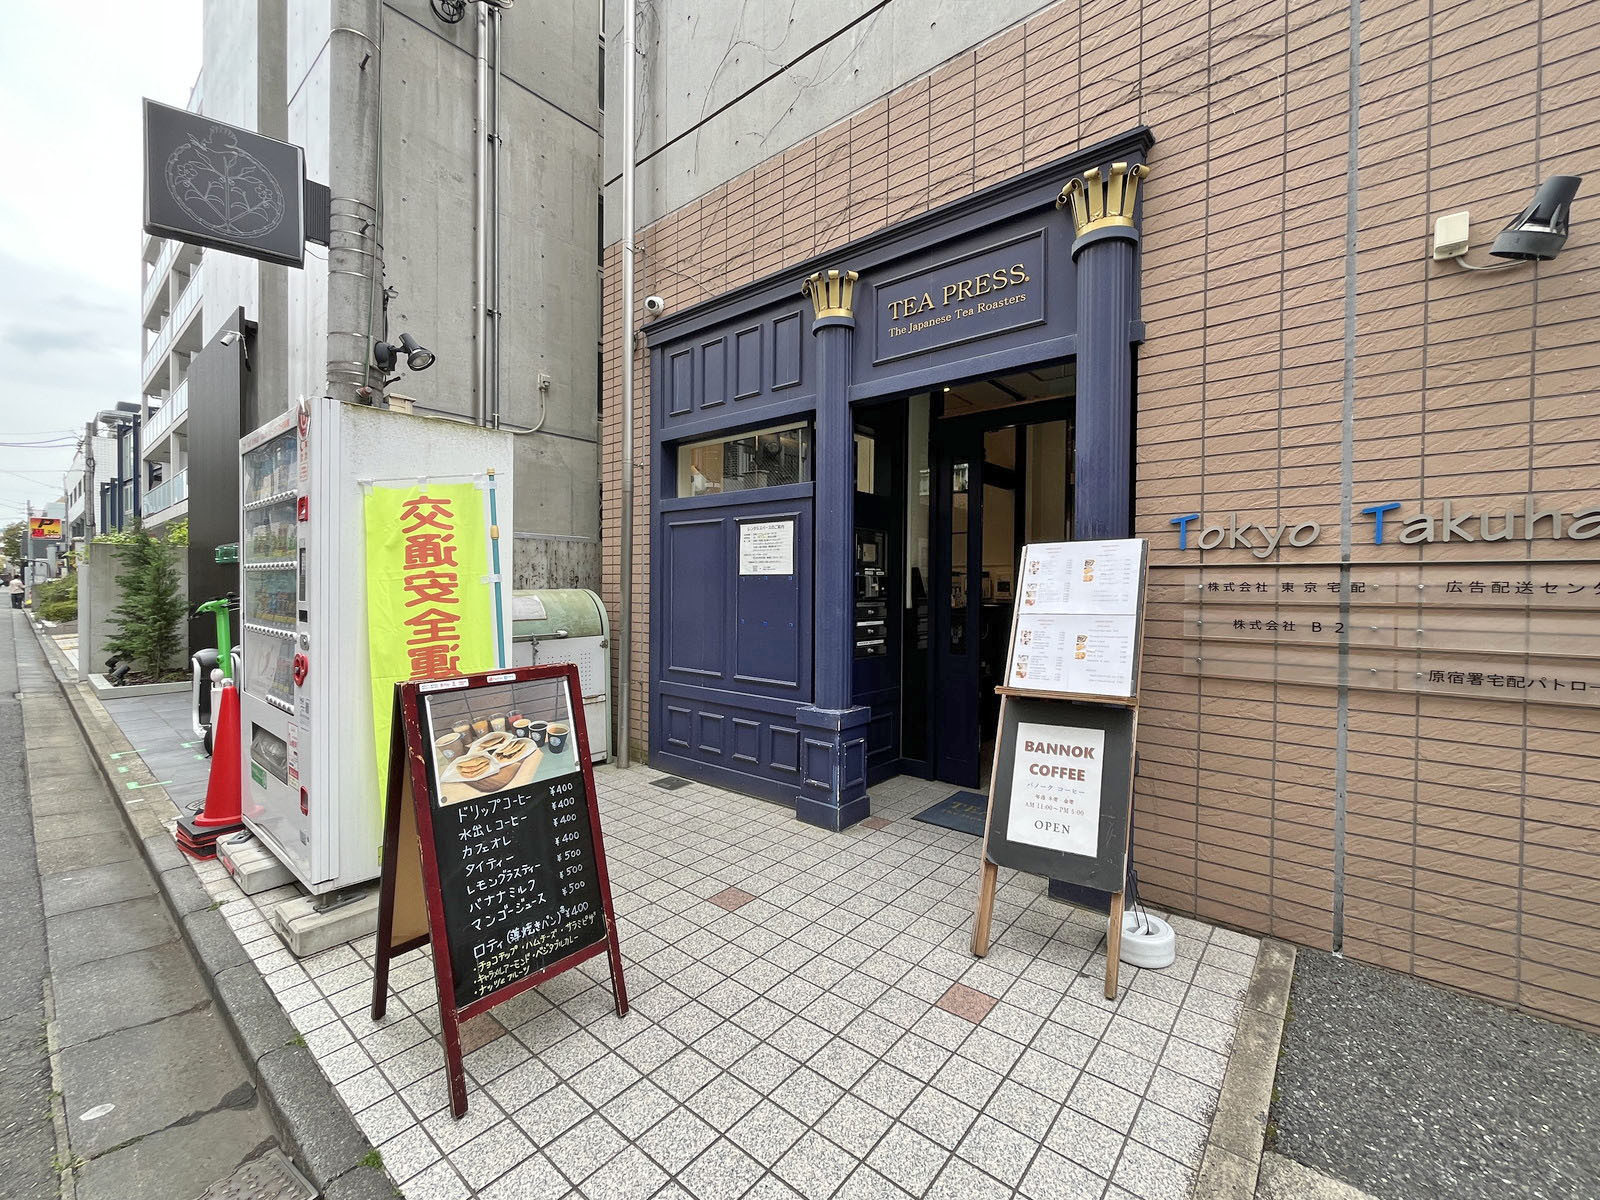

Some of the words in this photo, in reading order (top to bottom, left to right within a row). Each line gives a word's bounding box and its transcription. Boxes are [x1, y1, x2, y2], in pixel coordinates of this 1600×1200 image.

[888, 292, 934, 320] TEA
[942, 264, 1030, 306] PRESS.
[888, 326, 907, 338] The
[908, 314, 952, 333] Japanese
[955, 308, 974, 320] Tea
[977, 294, 1026, 313] Roasters
[1170, 512, 1321, 559] Tokyo
[1207, 581, 1268, 593] 株式会社
[1232, 619, 1296, 632] 株式会社
[1024, 740, 1095, 759] BANNOK
[1029, 763, 1086, 782] COFFEE
[458, 794, 532, 823] ドリップコーヒー
[459, 814, 528, 841] 水出しコーヒー
[1034, 820, 1071, 835] OPEN
[462, 835, 512, 860] カフェオレ
[465, 854, 515, 877] タイティー
[467, 863, 542, 895] レモングラスティー
[470, 893, 547, 931] マンゴージュース
